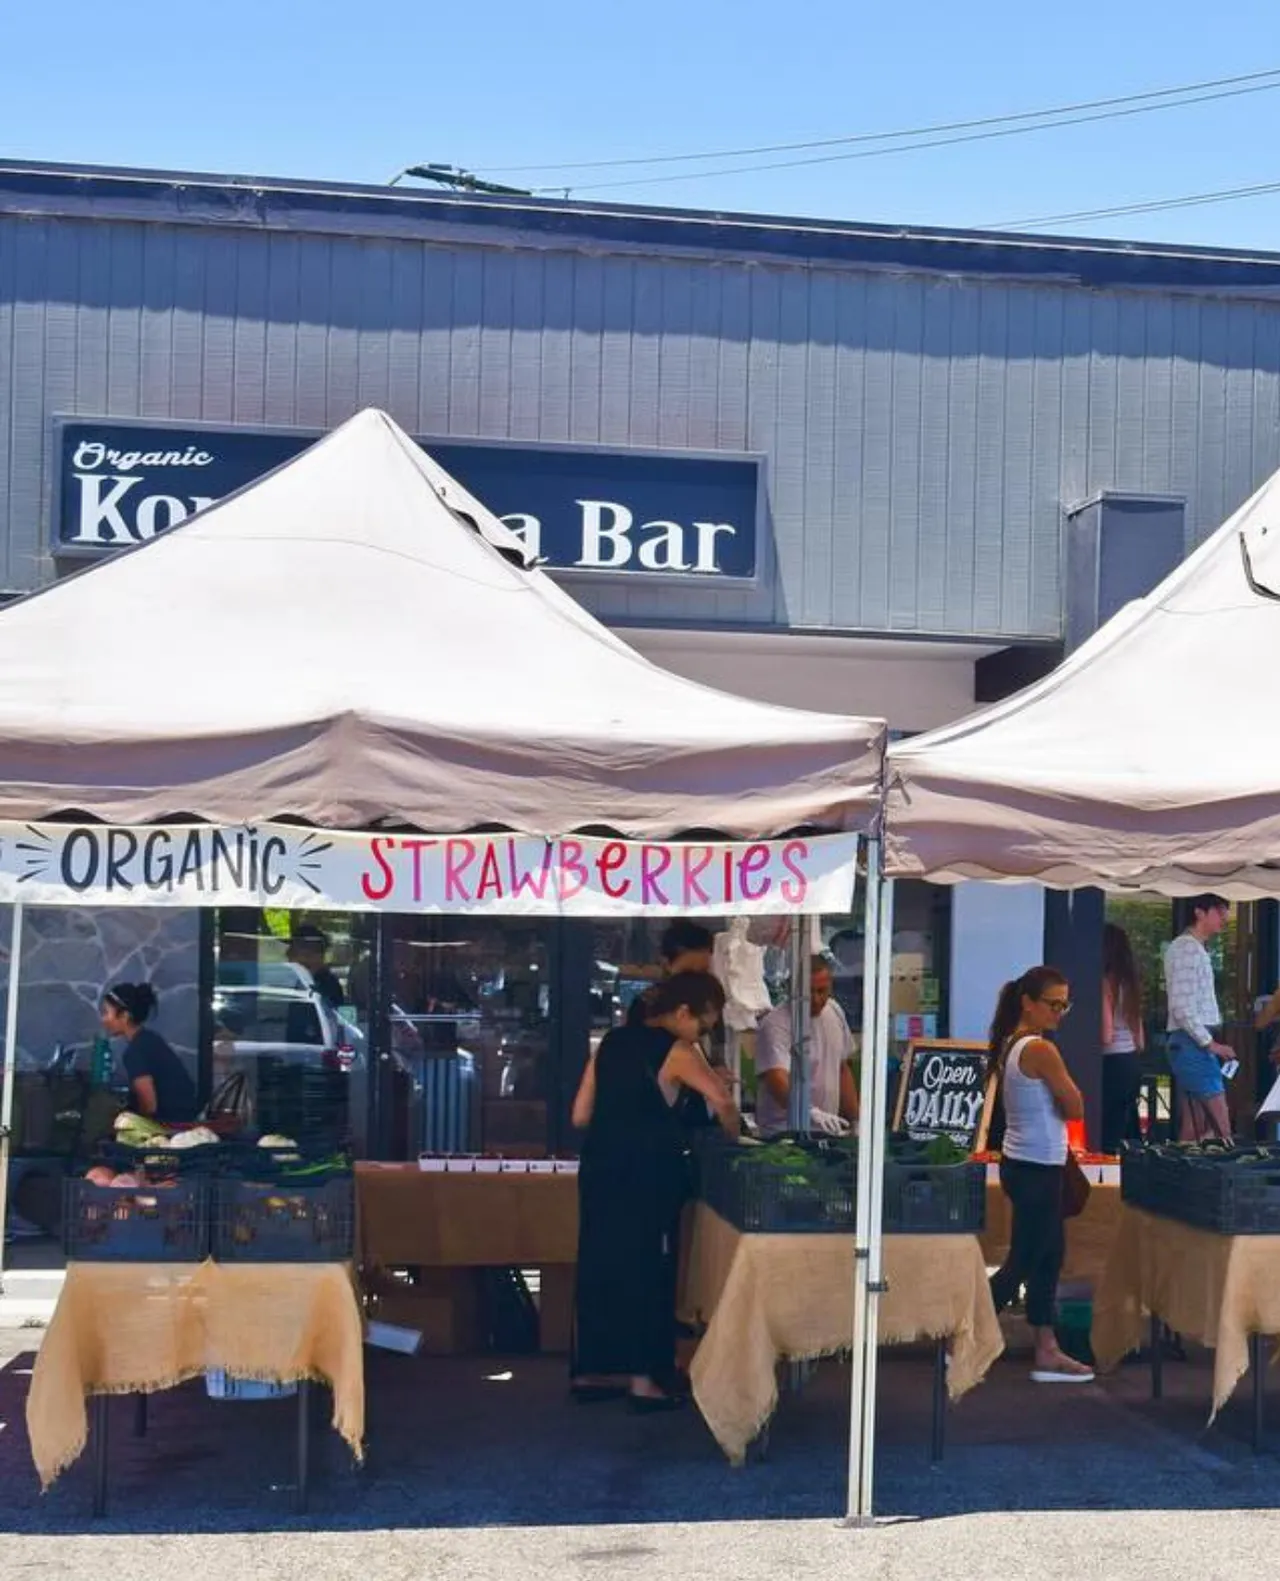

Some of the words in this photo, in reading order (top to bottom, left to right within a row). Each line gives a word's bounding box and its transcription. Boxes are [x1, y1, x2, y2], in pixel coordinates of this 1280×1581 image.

[73, 441, 213, 470] Organic
[574, 499, 736, 572] Bar
[923, 1056, 977, 1092] Open
[905, 1088, 984, 1129] DAILY
